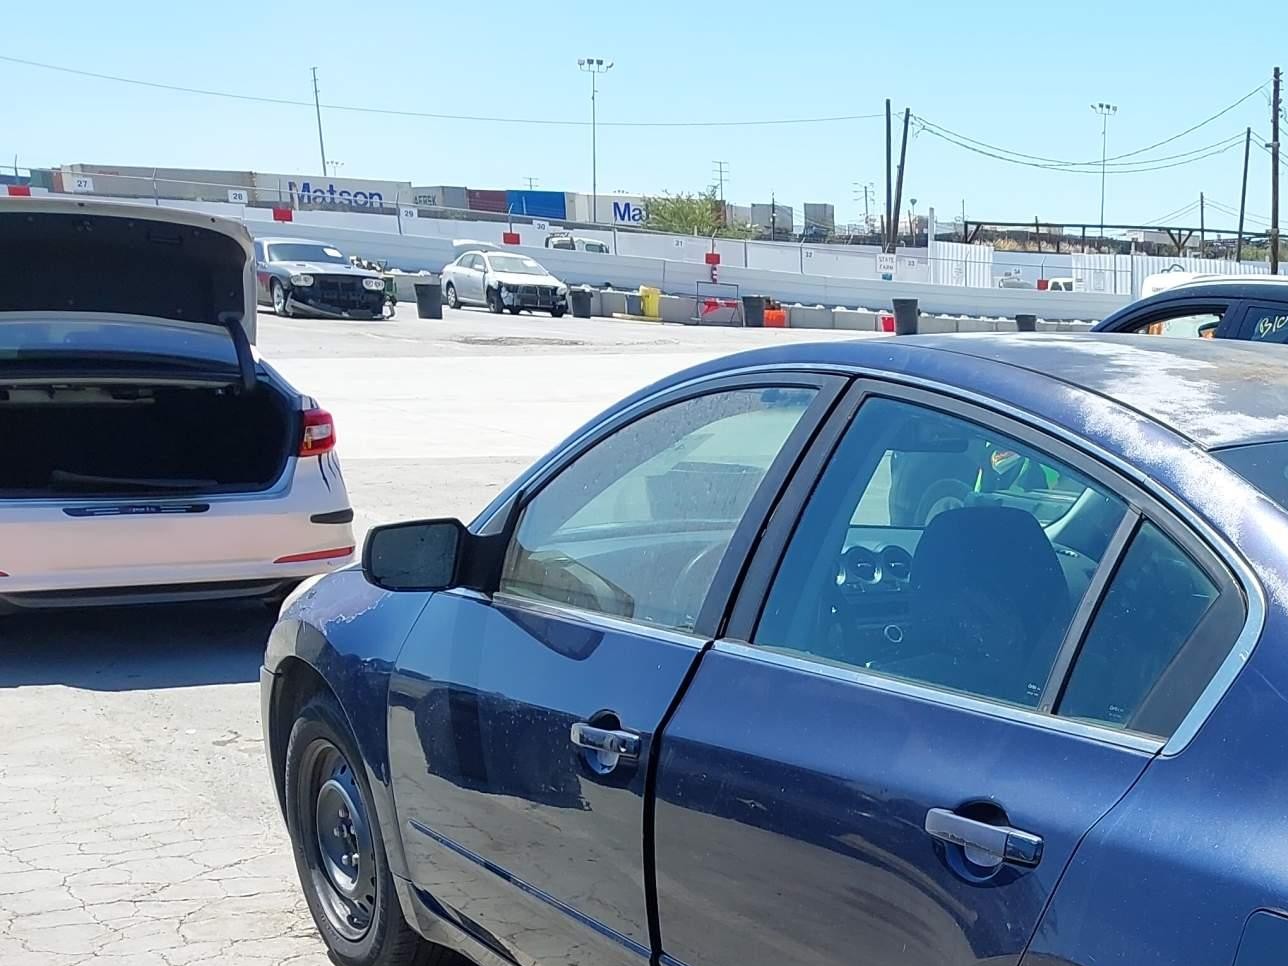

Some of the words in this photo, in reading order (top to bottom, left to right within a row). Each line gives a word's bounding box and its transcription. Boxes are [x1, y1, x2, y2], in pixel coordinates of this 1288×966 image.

[77, 179, 88, 188] 27
[288, 181, 384, 208] Matson
[404, 209, 414, 218] 29
[536, 223, 546, 231] 30
